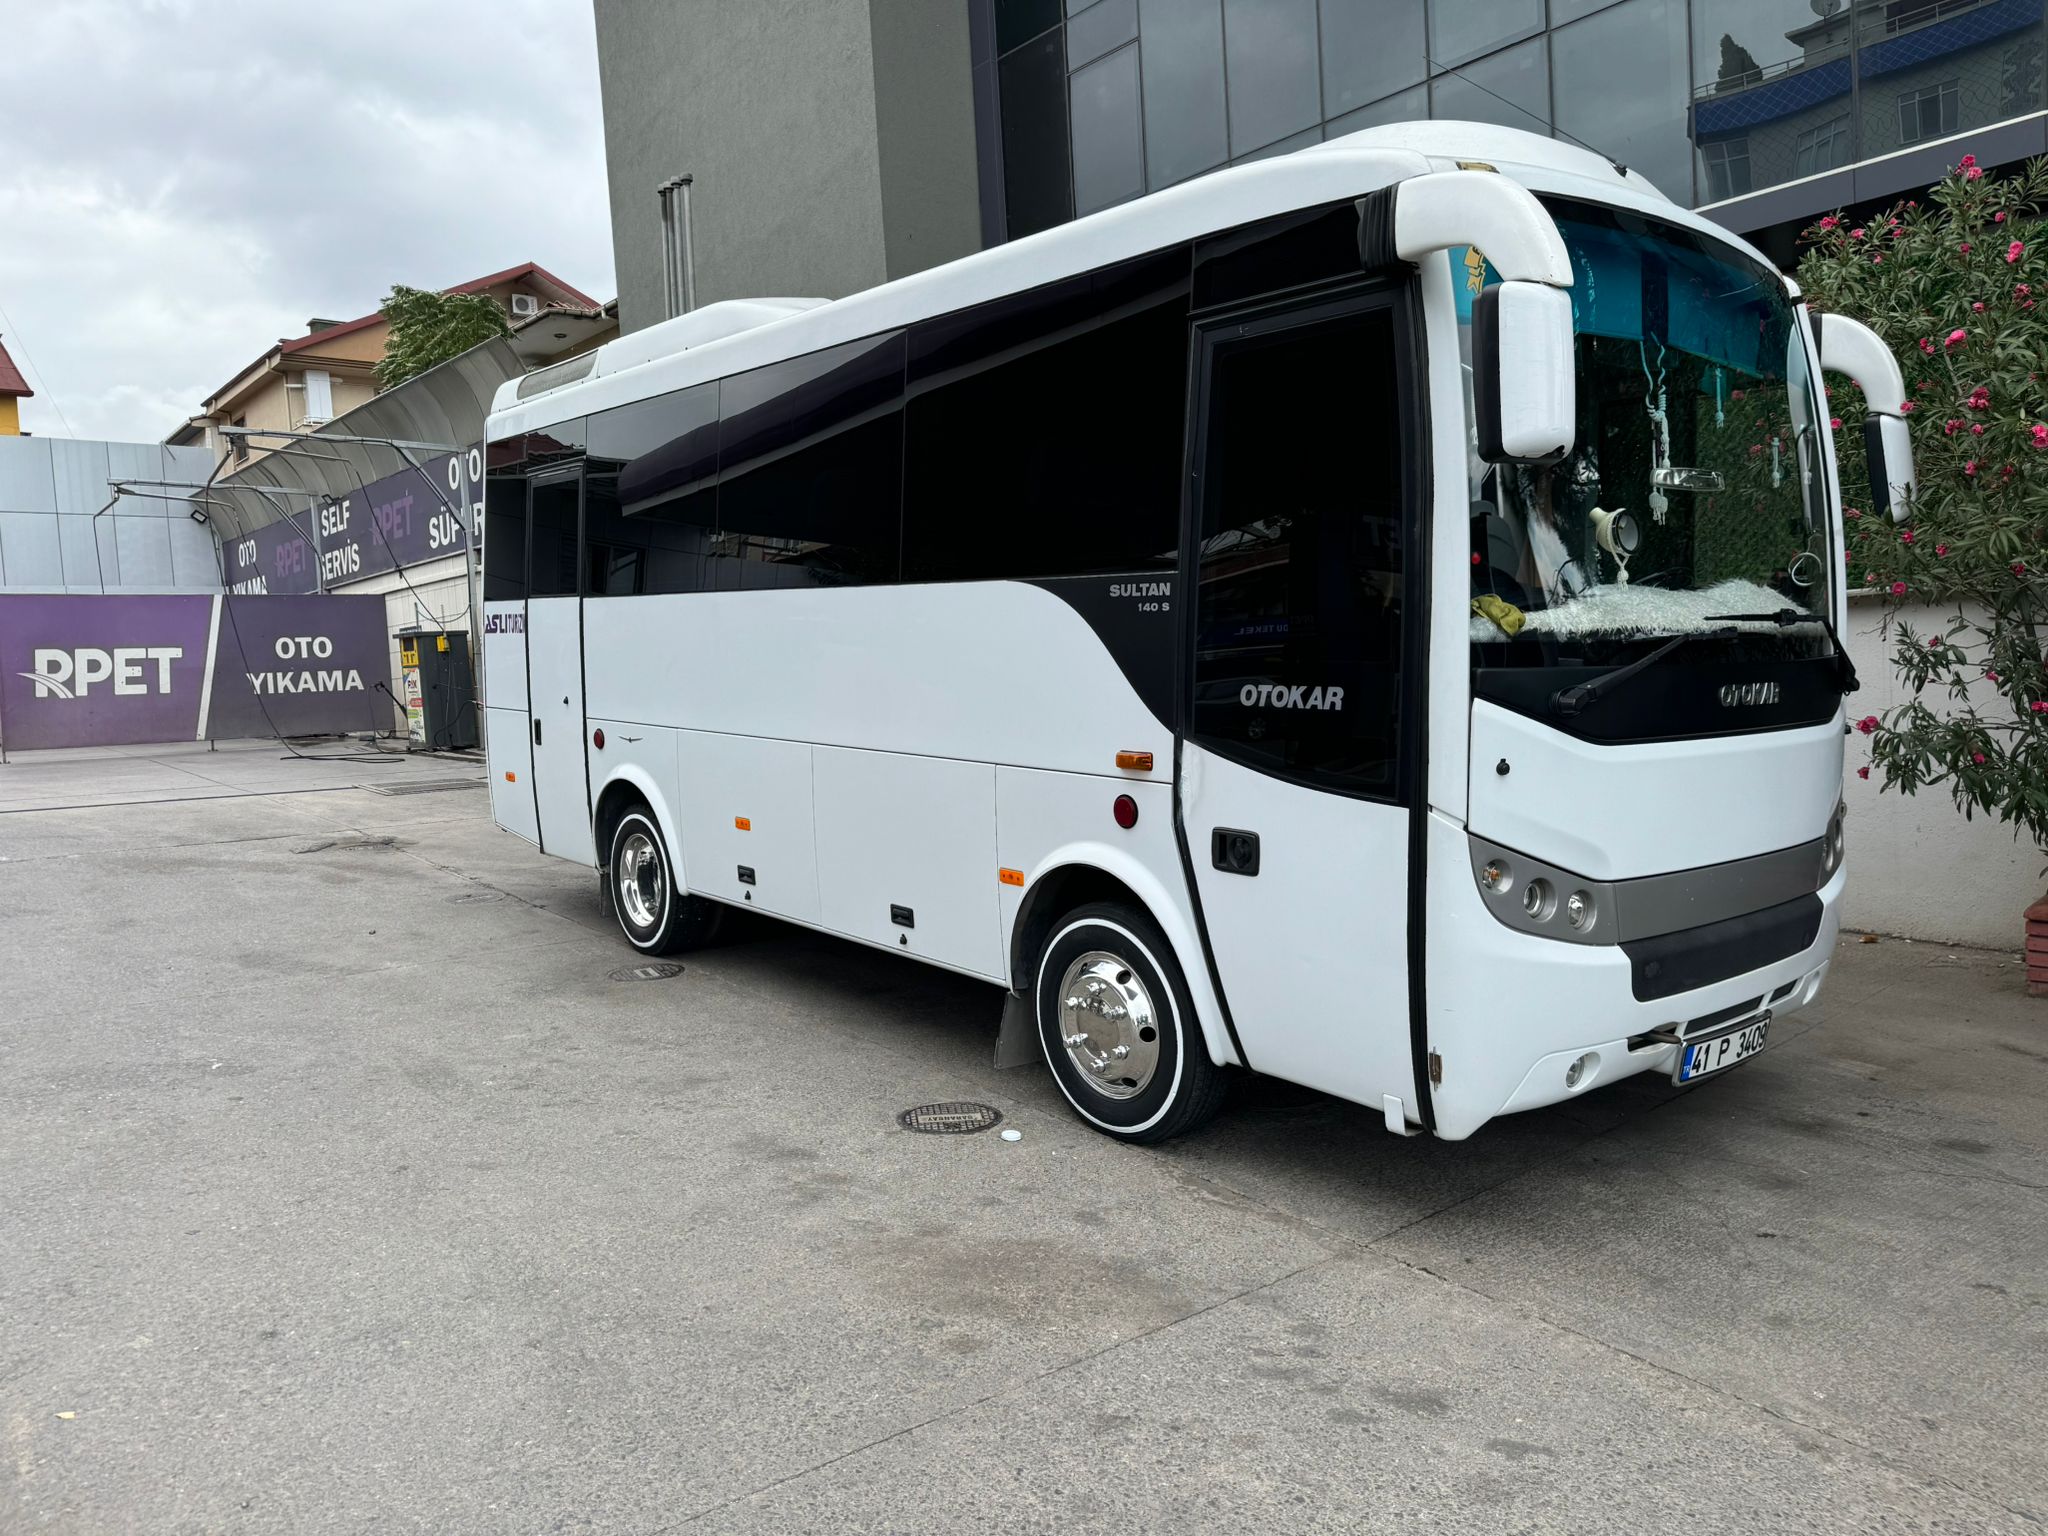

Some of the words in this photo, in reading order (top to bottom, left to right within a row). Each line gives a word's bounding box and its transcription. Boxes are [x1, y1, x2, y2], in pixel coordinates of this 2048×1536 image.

[448, 447, 482, 491] OO
[321, 499, 350, 537] SELF
[429, 502, 483, 549] SÜPR
[238, 539, 257, 568] OTO
[1109, 582, 1171, 597] SULTAN
[1137, 602, 1159, 612] 140
[1161, 602, 1170, 612] S
[275, 637, 333, 659] OTO
[16, 648, 183, 699] RPET
[246, 669, 365, 695] YIKAMA
[1240, 684, 1344, 711] OTOKAR
[1692, 1043, 1711, 1073] 41
[1717, 1038, 1731, 1066] P
[1736, 1022, 1768, 1059] 3409
